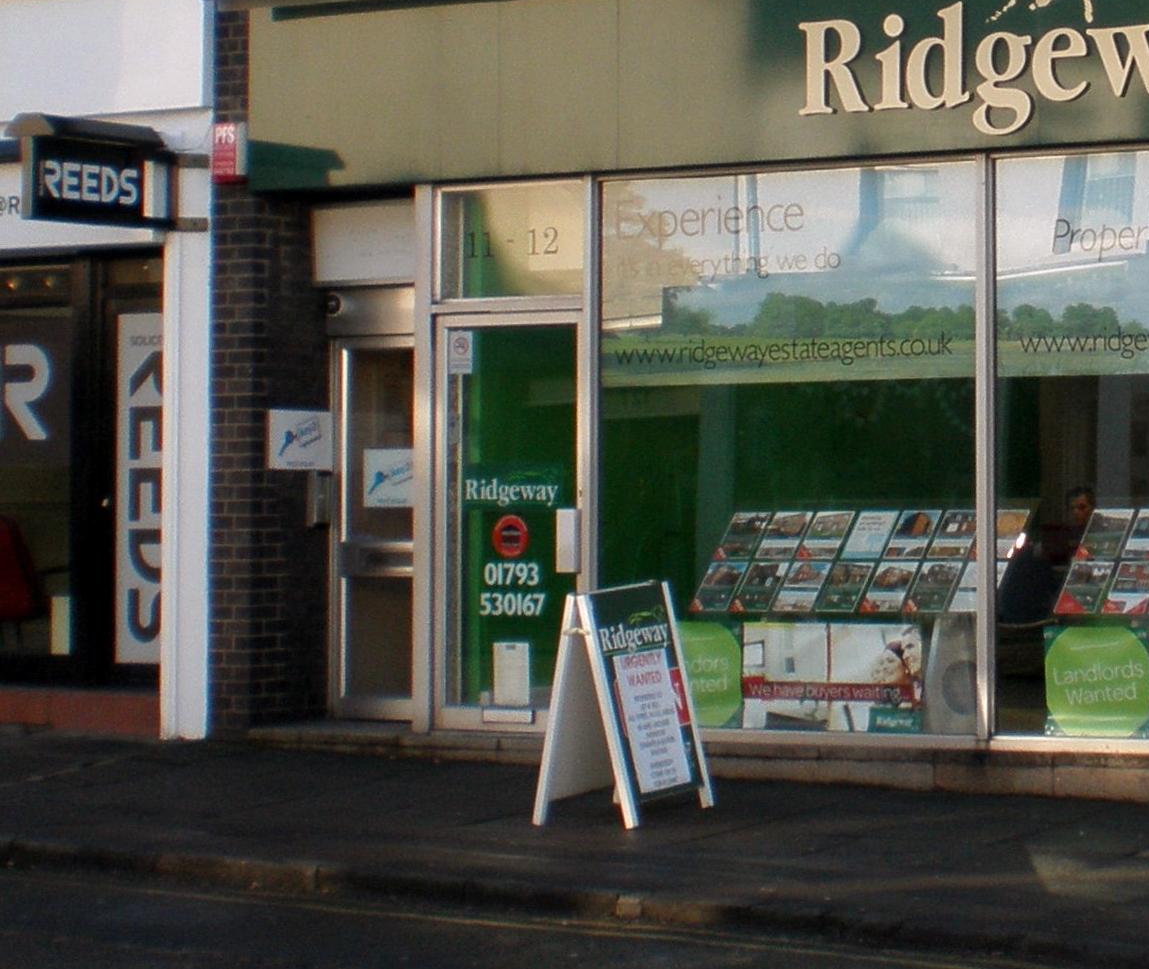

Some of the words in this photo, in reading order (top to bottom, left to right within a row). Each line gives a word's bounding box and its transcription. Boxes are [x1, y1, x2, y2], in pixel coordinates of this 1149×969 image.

[39, 160, 138, 205] REEDS
[615, 195, 805, 249] Experience
[527, 226, 560, 256] 12
[776, 253, 808, 271] we
[814, 246, 842, 270] do
[614, 330, 953, 370] www.ridgewayestateagents.co.uk
[465, 478, 559, 507] Ridgeway
[484, 563, 540, 585] 01793
[479, 592, 546, 616] 530167
[599, 623, 668, 654] Ridgeway
[1053, 658, 1145, 686] Landlords
[751, 683, 770, 697] We
[773, 683, 803, 697] have
[806, 683, 849, 701] buyers
[1065, 682, 1138, 705] Wanted
